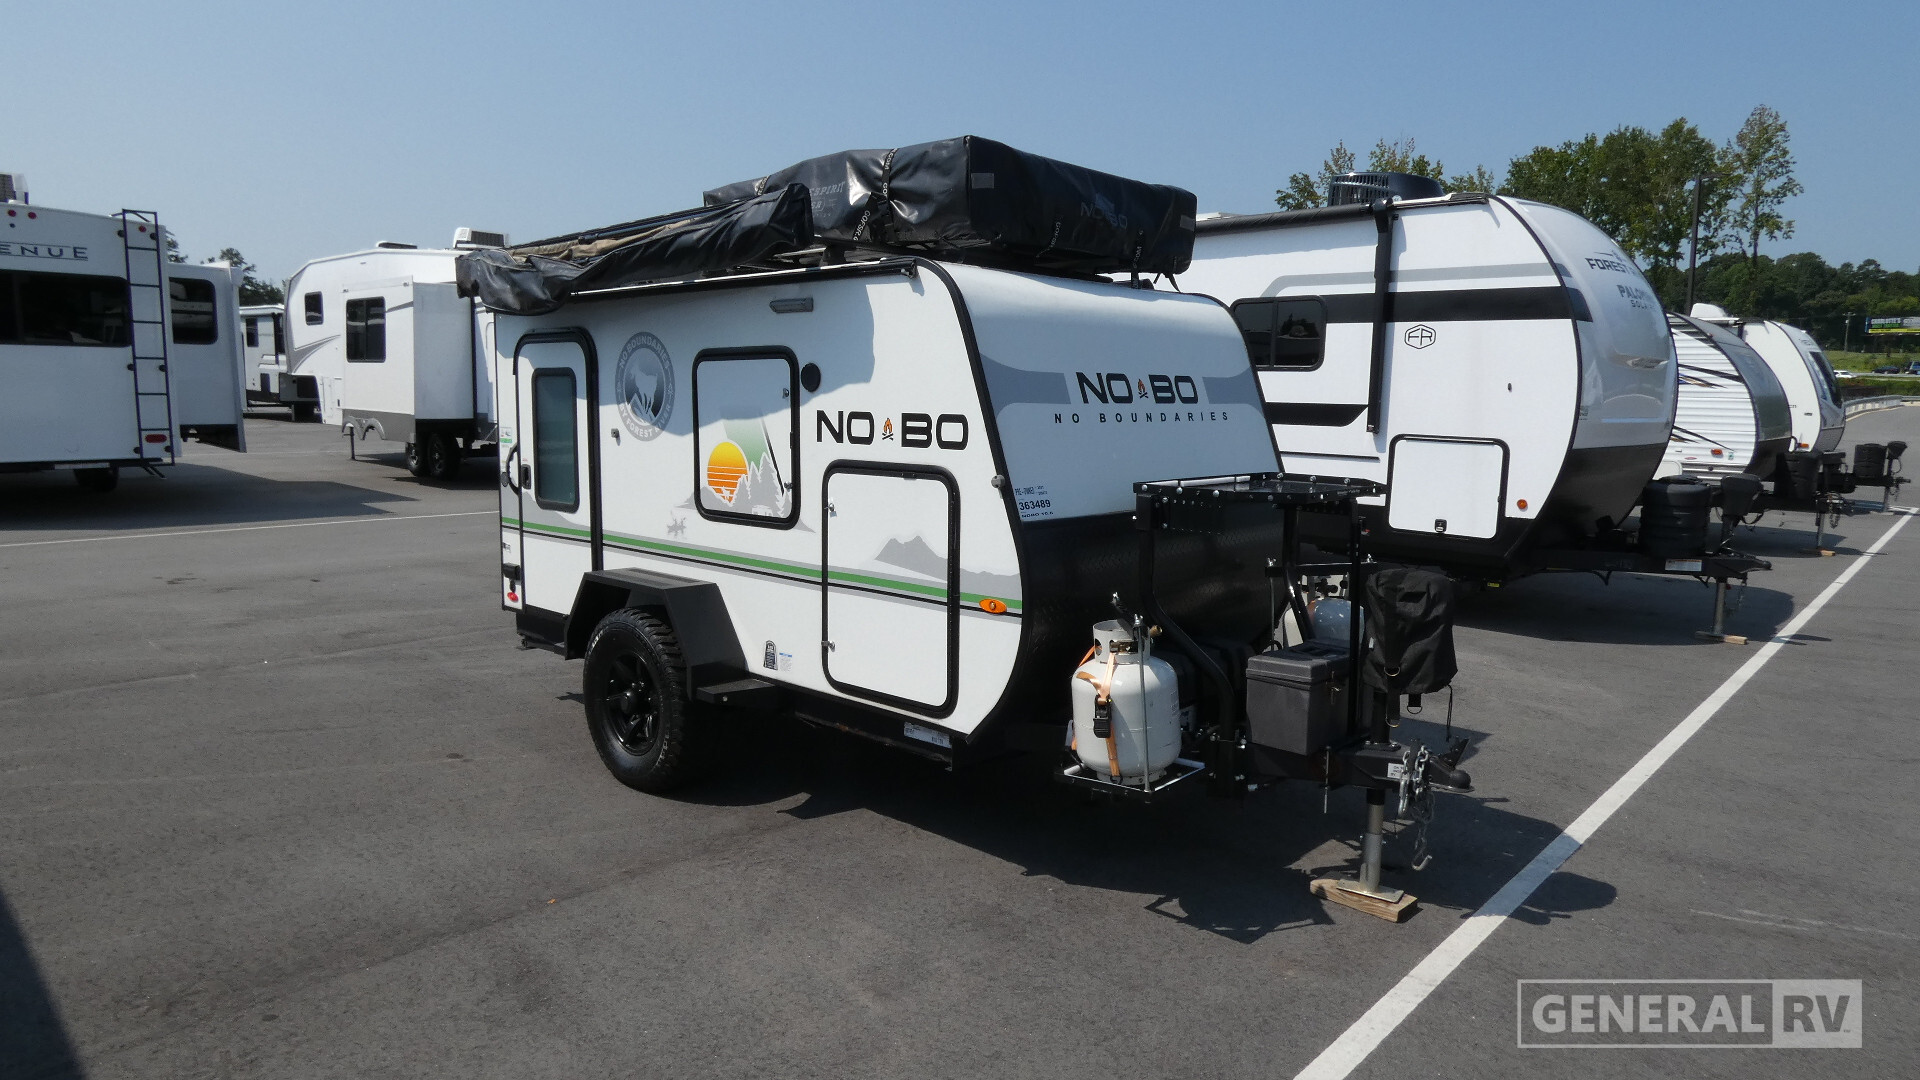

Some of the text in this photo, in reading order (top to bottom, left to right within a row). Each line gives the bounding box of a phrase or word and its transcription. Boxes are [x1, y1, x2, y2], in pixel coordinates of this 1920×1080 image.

[627, 335, 671, 369] BOUNDARIES
[1054, 412, 1228, 424] NO BOUNDARIES
[626, 418, 653, 438] FOREST
[1019, 500, 1051, 510] 363489
